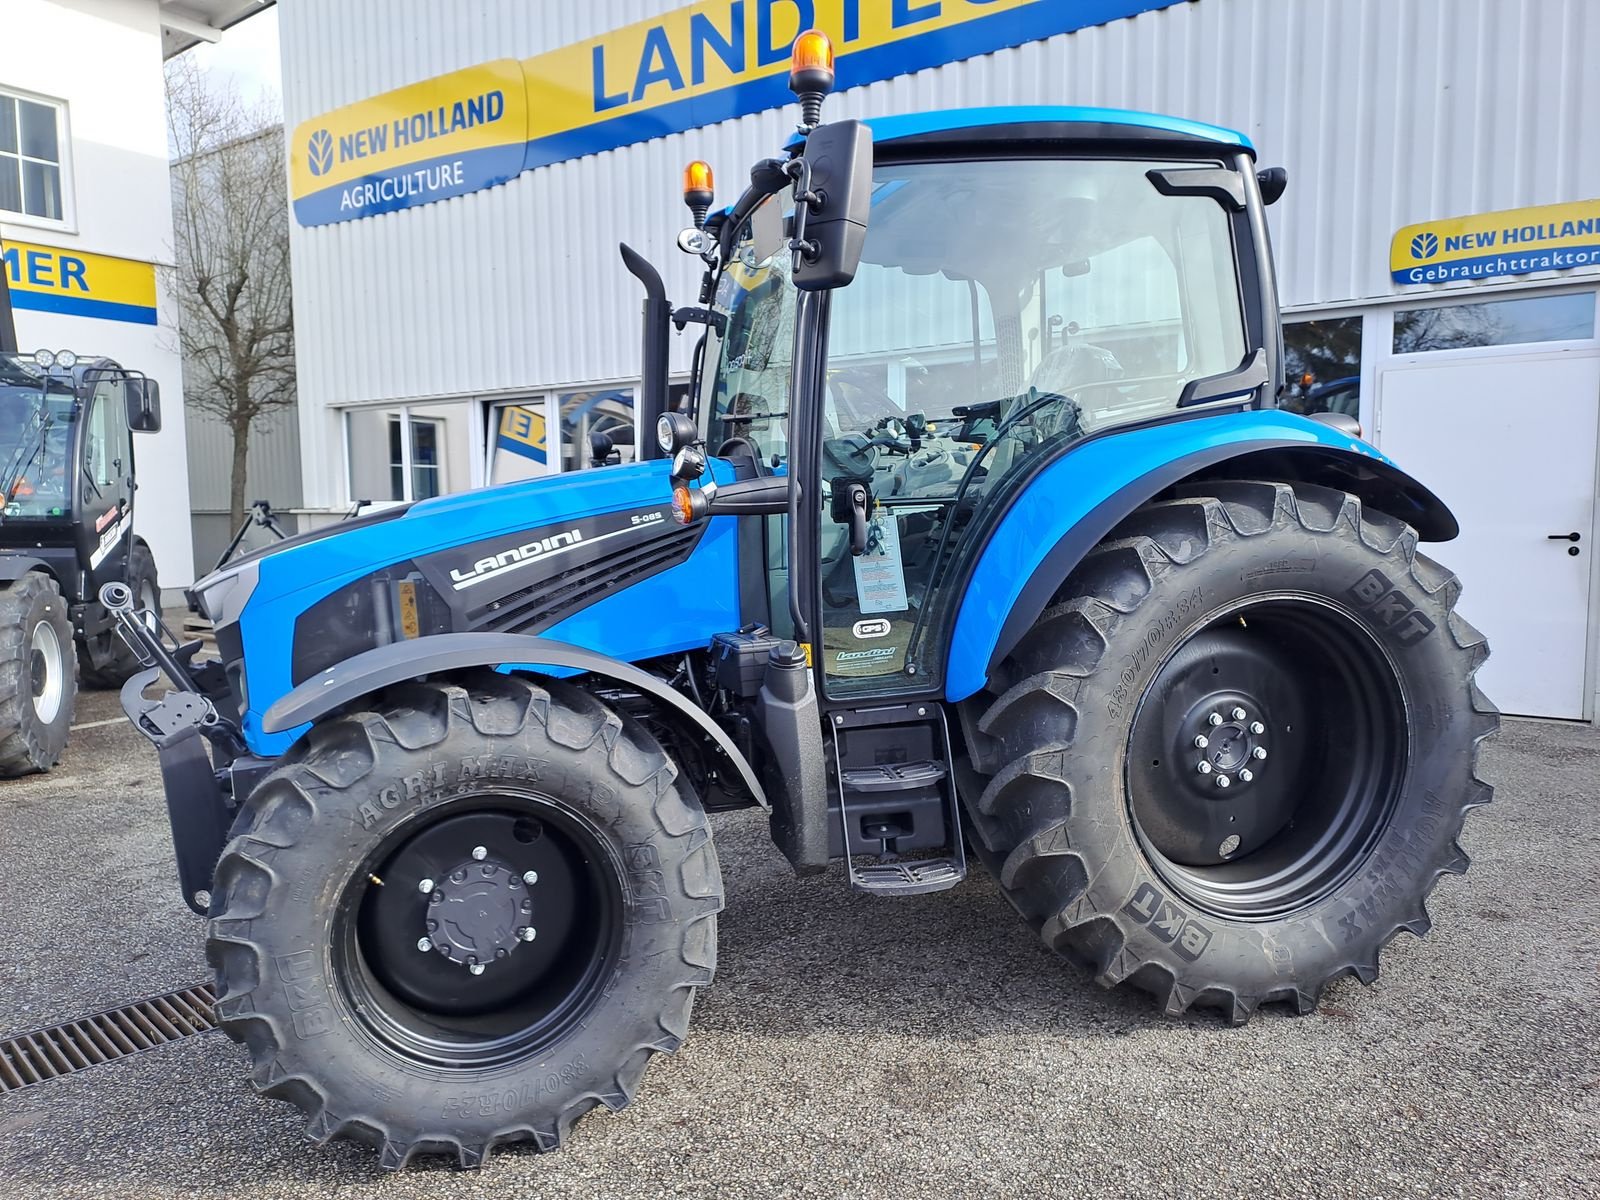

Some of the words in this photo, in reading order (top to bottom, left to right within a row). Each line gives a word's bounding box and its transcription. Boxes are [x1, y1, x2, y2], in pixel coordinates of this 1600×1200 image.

[339, 123, 388, 163] NEW
[394, 90, 504, 149] HOLLAND
[340, 160, 465, 212] AGRICULTURE
[1445, 230, 1497, 252] NEW
[449, 529, 583, 581] LANDINI
[1352, 573, 1430, 641] BKT
[1131, 890, 1209, 957] BKT
